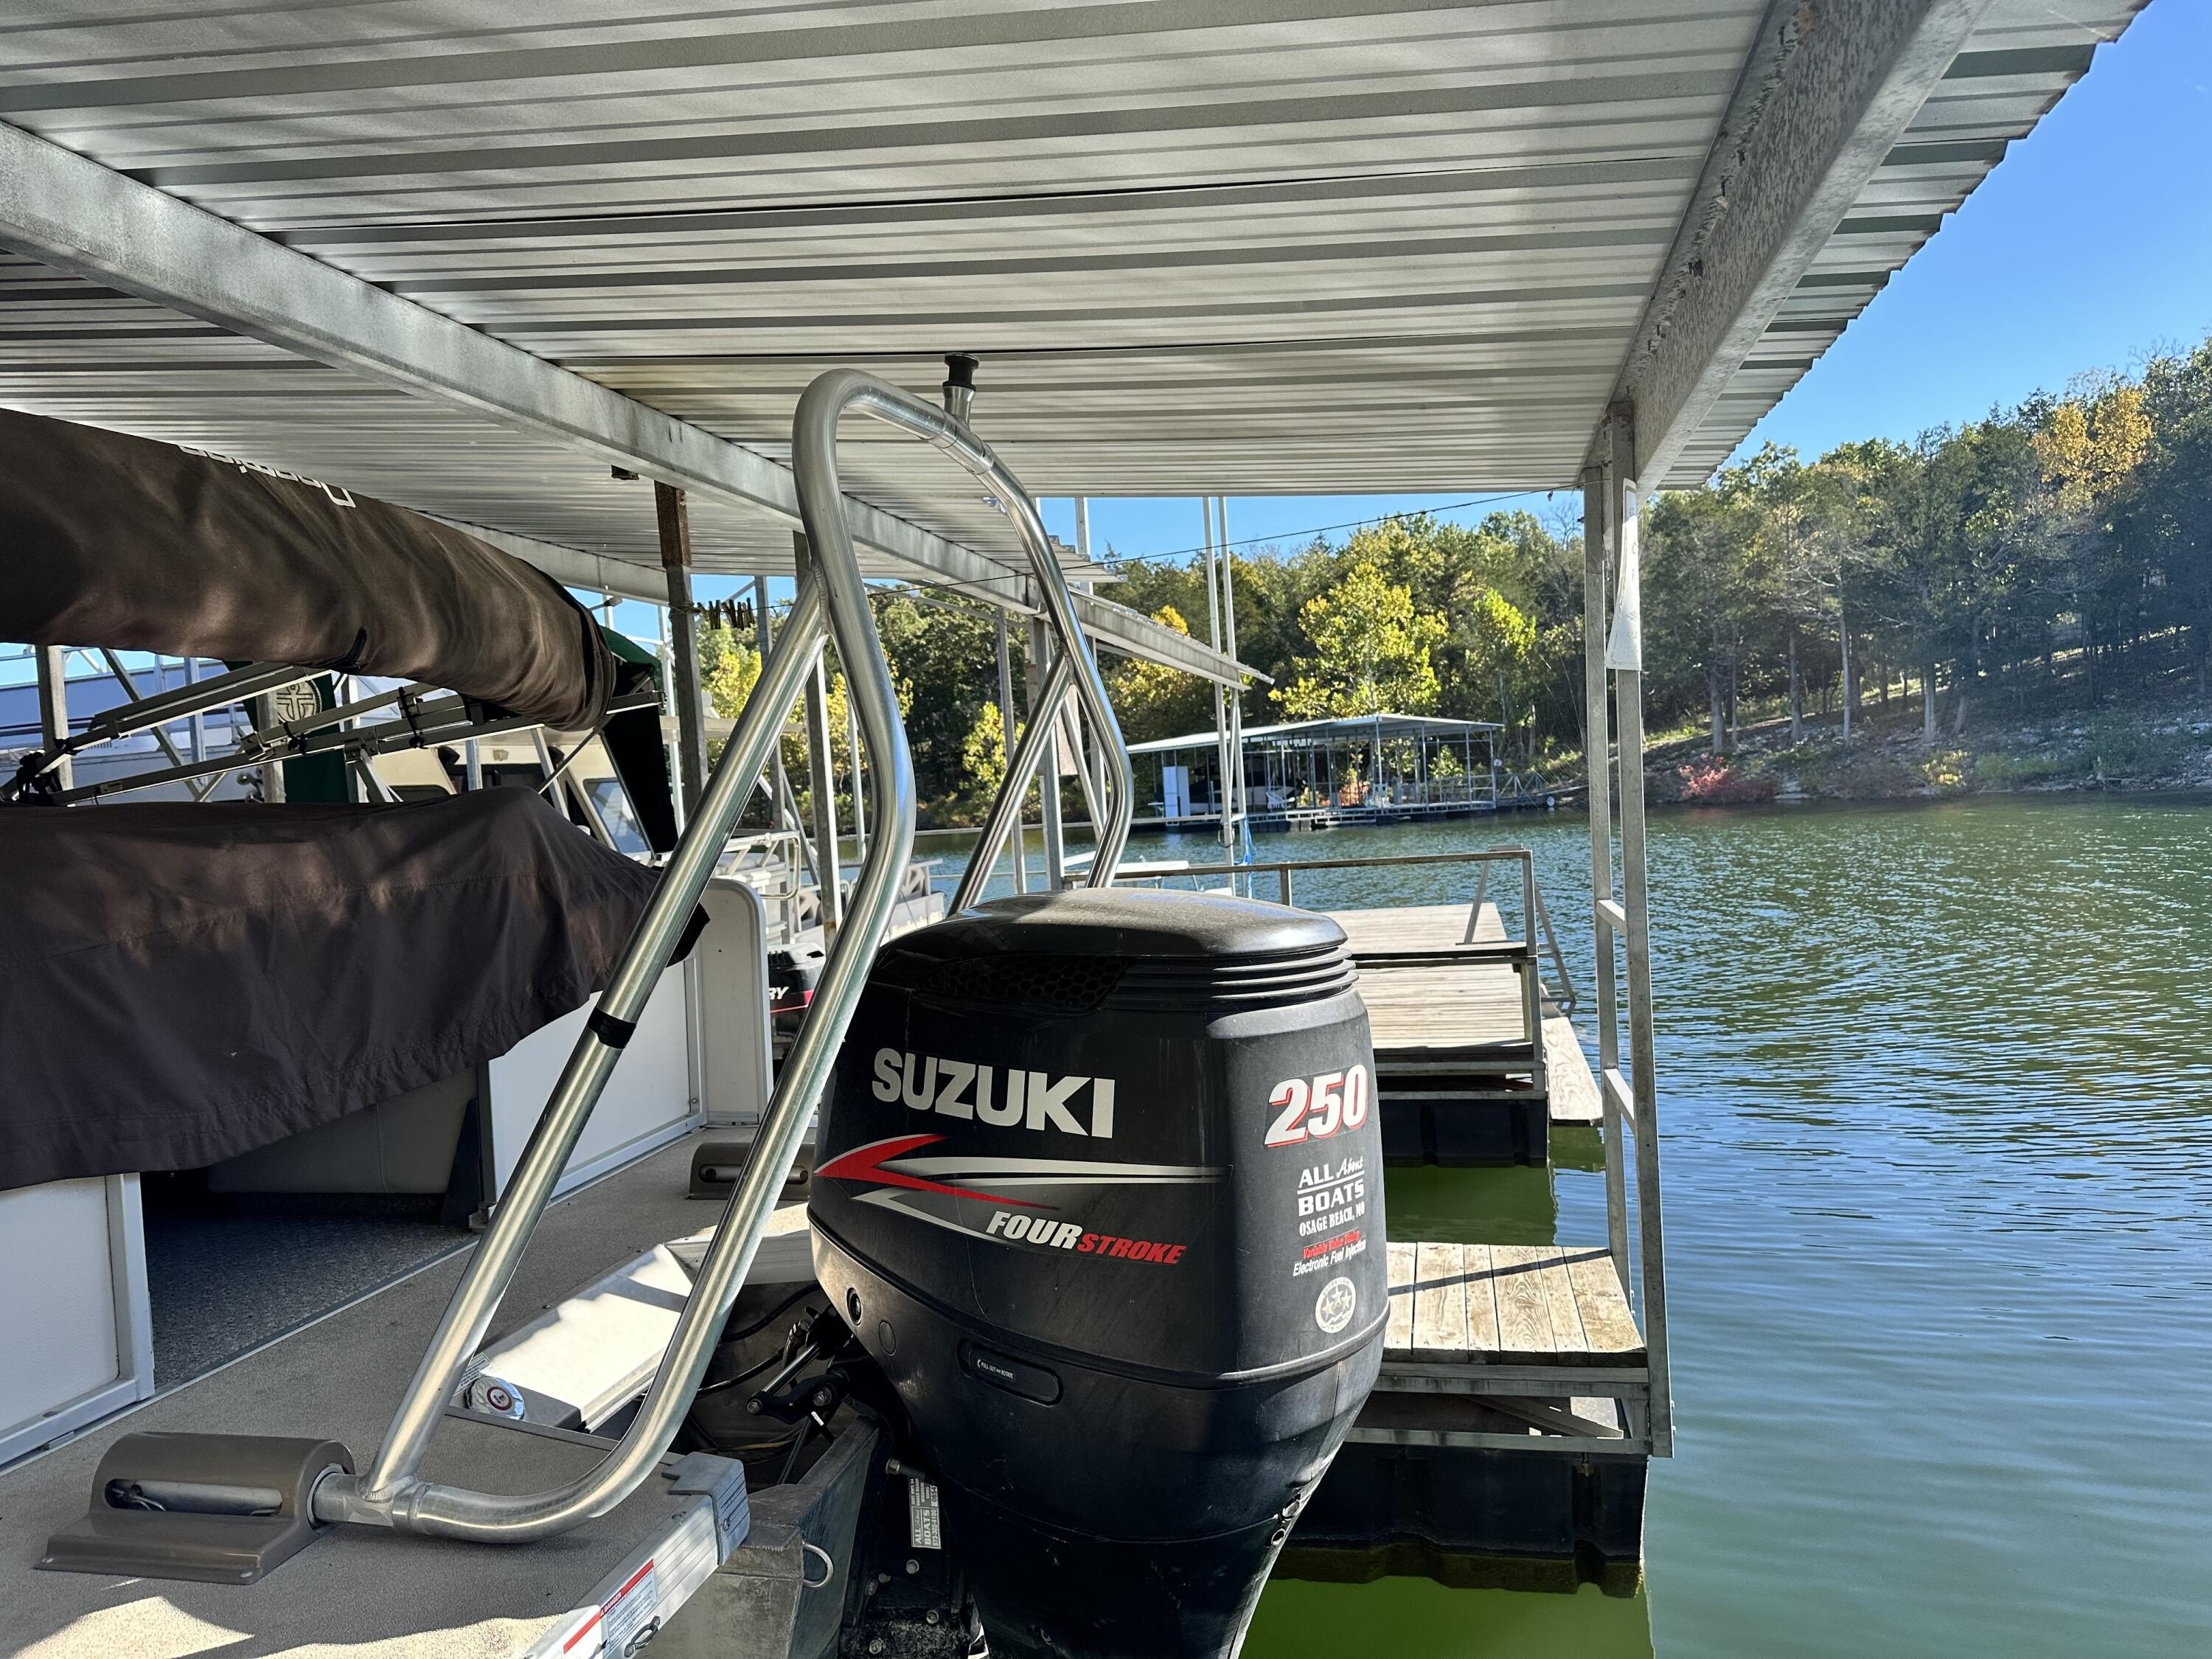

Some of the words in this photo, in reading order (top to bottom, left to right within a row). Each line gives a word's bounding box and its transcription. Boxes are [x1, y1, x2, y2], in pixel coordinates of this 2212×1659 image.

[872, 1048, 1116, 1138] SUZUKI
[1265, 1064, 1368, 1147] 250
[1298, 1164, 1334, 1189] ALL
[1336, 1155, 1363, 1178] About
[1298, 1178, 1365, 1217] BOATS
[1299, 1215, 1328, 1237] OSAGE
[1356, 1200, 1365, 1217] MO
[985, 1210, 1084, 1250] FOUR
[1077, 1234, 1187, 1265] STROKE
[1293, 1254, 1329, 1276] Electronic
[1330, 1247, 1344, 1265] Fuel
[1345, 1239, 1366, 1260] Injection
[922, 1509, 931, 1545] BOATS
[604, 1591, 622, 1612] DANGER
